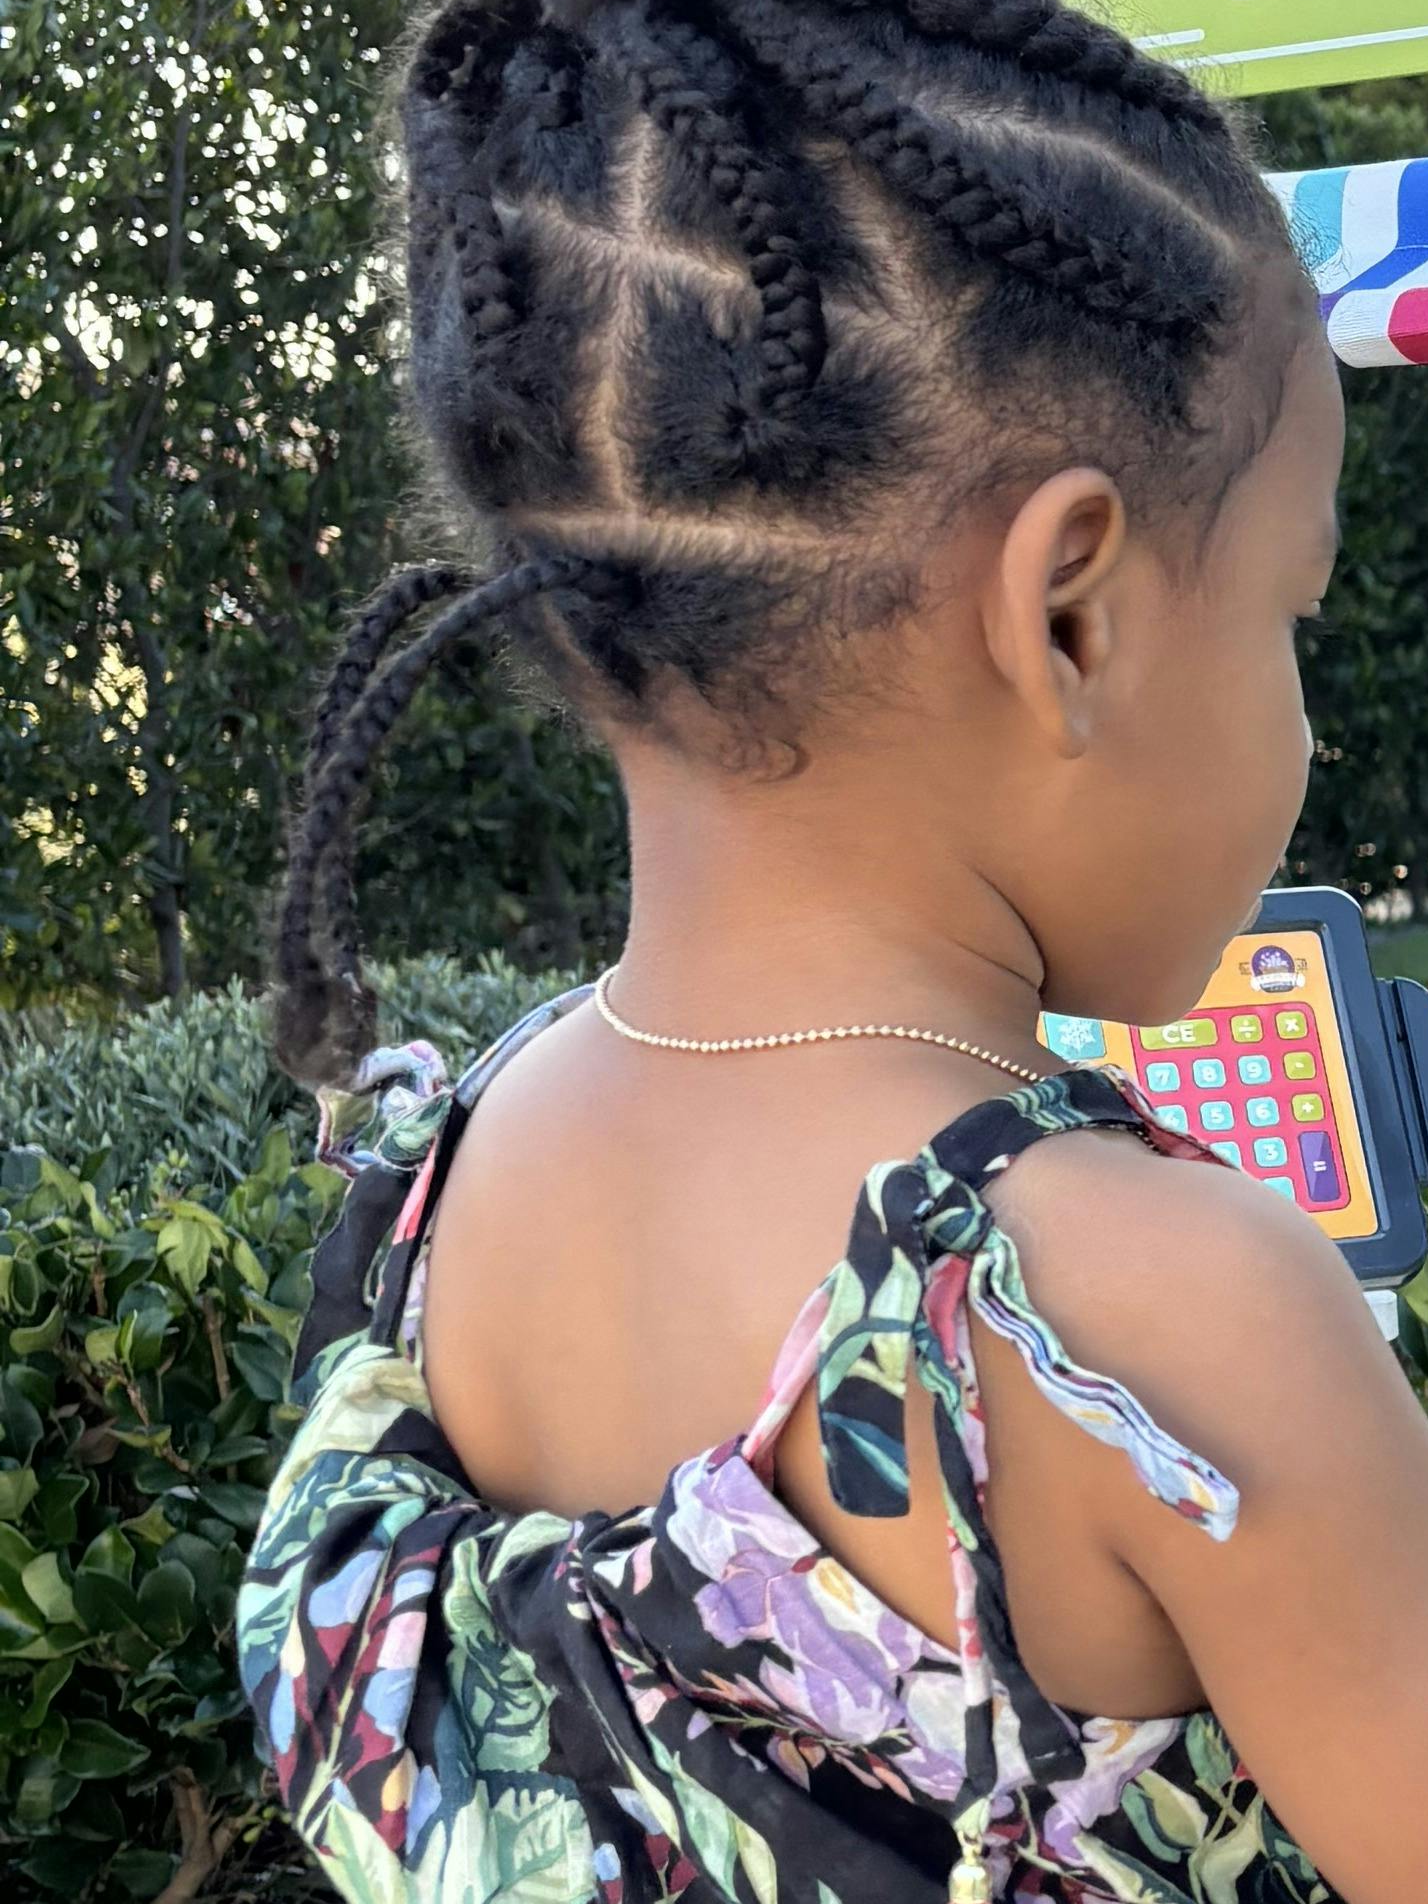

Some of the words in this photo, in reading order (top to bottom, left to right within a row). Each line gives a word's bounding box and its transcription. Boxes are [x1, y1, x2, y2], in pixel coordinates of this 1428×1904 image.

[1162, 1024, 1196, 1043] CE
[1155, 1068, 1170, 1086] 7
[1202, 1065, 1217, 1082] 8
[1247, 1061, 1263, 1079] 9
[1210, 1107, 1225, 1124] 5
[1255, 1103, 1271, 1120] 6
[1263, 1144, 1279, 1161] 3
